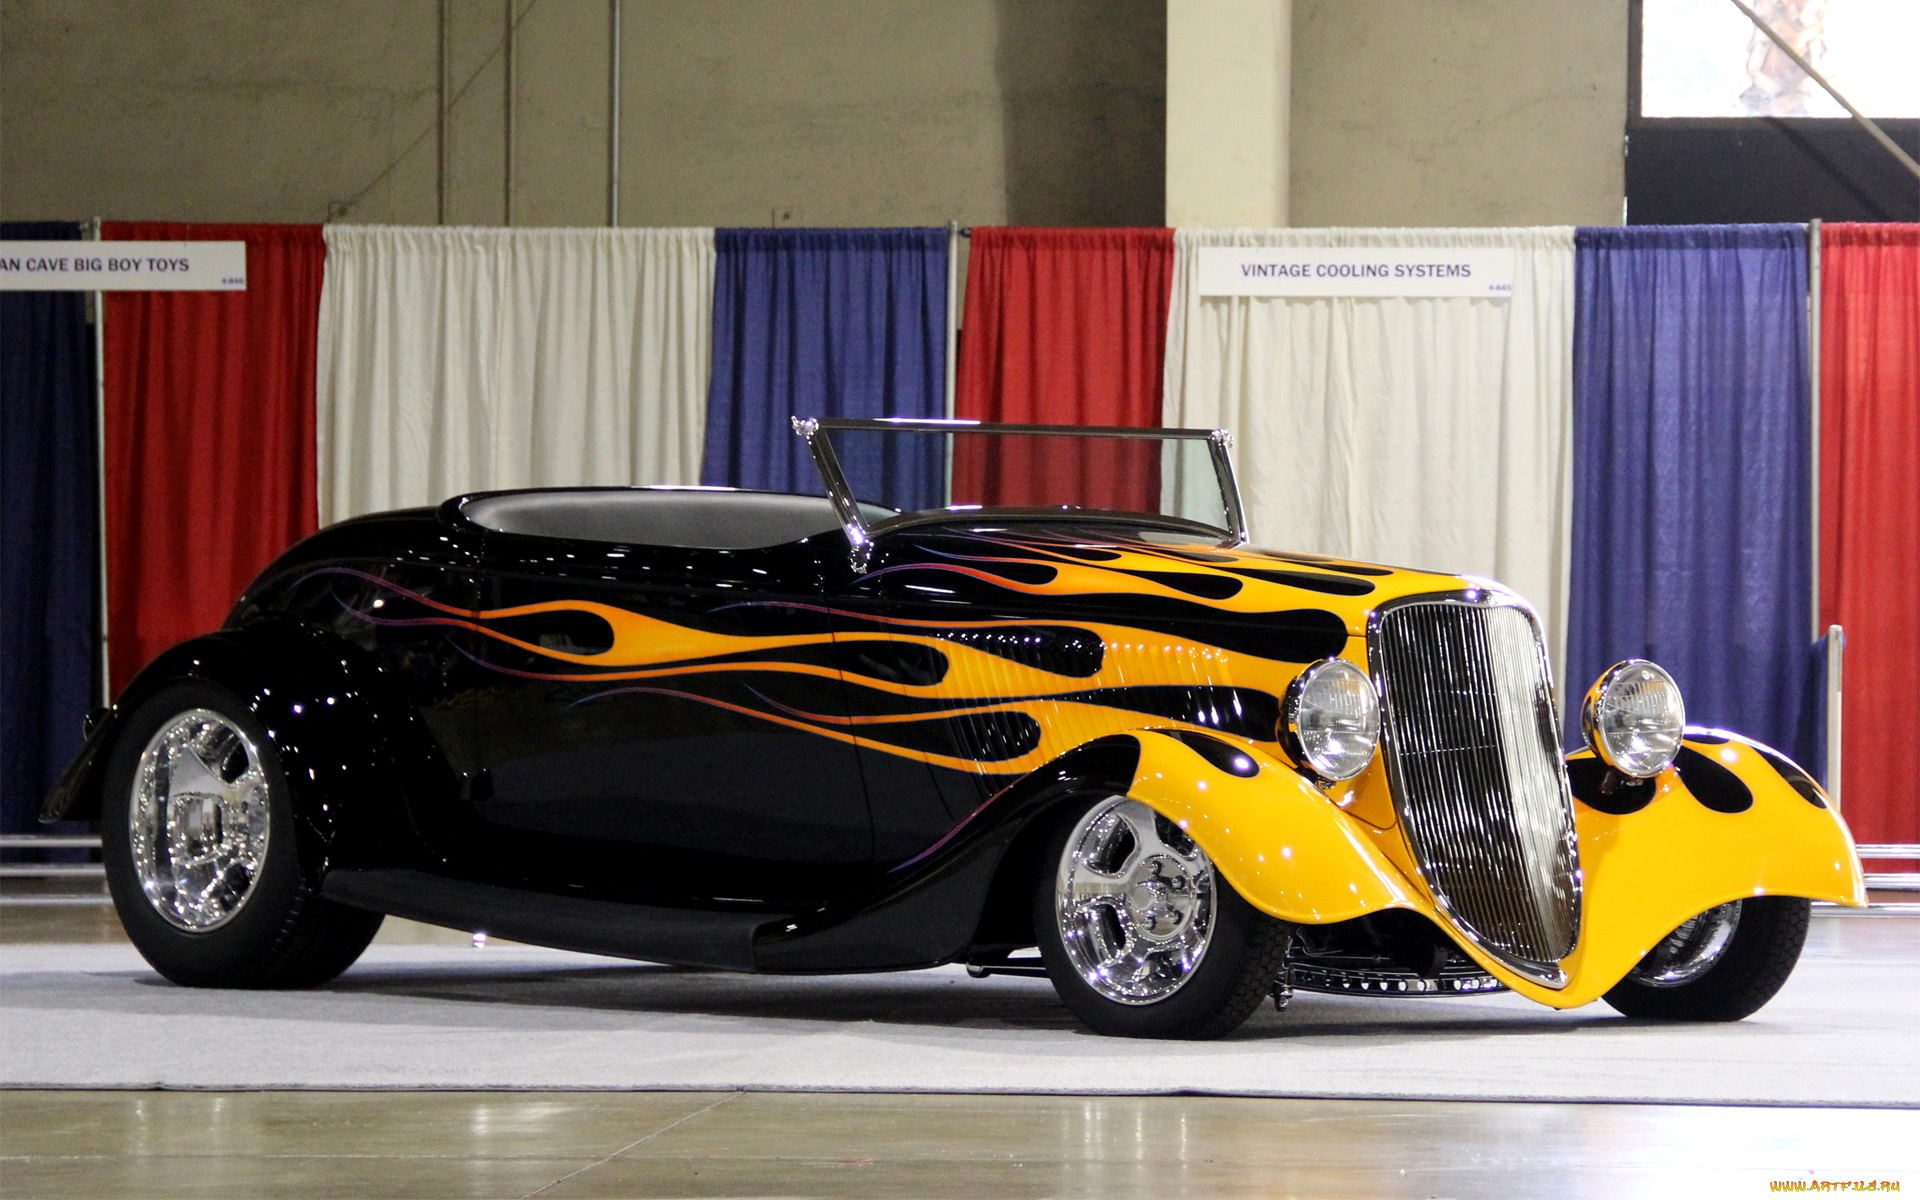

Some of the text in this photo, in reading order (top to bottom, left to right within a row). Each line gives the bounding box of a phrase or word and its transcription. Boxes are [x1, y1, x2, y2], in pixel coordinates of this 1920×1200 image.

[26, 258, 68, 271] CAVE
[74, 258, 102, 271] BIG
[108, 258, 142, 271] BOY
[147, 258, 190, 272] TOYS
[1241, 264, 1471, 277] VINTAGE COOLING SYSTEMS
